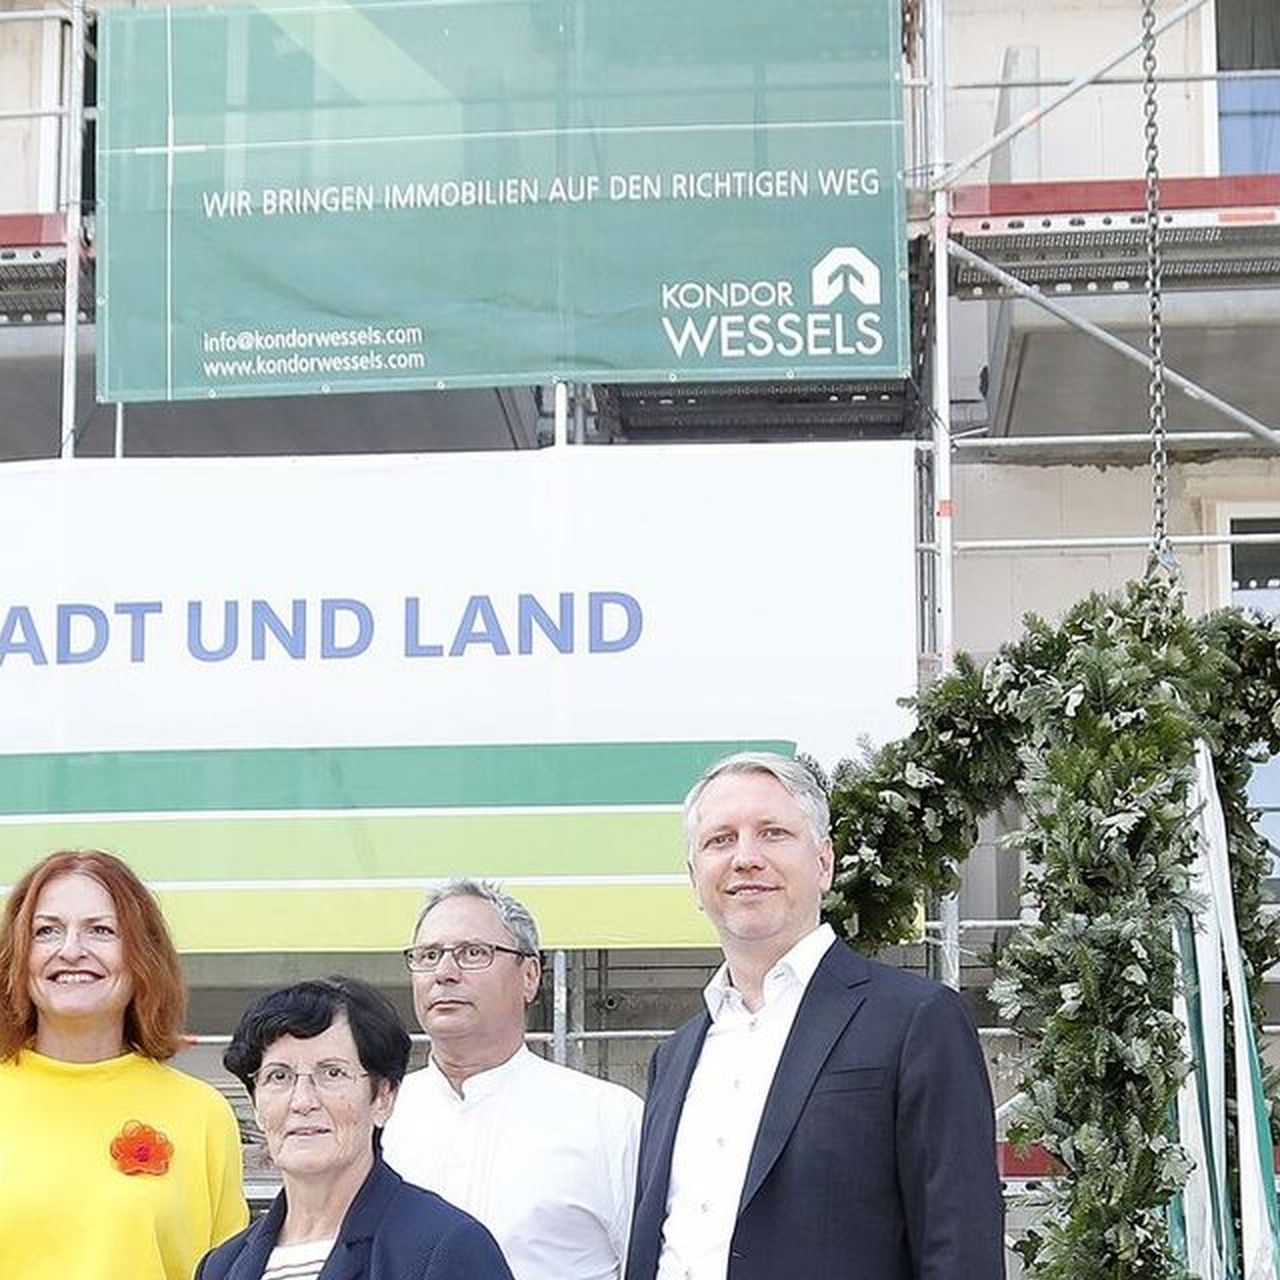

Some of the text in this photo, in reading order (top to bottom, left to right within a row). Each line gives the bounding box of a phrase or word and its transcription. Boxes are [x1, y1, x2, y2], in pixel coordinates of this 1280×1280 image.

[202, 168, 880, 217] WIR BRINGEN IMMOBILIEN AUF DEN RICHTIGEN WEG
[661, 280, 794, 309] KONDOR
[203, 325, 423, 352] info@kondorwessels.com
[661, 311, 884, 359] WESSELS
[203, 350, 425, 378] www.kondorwessels.com
[185, 596, 376, 664] UND
[403, 591, 644, 658] LAND
